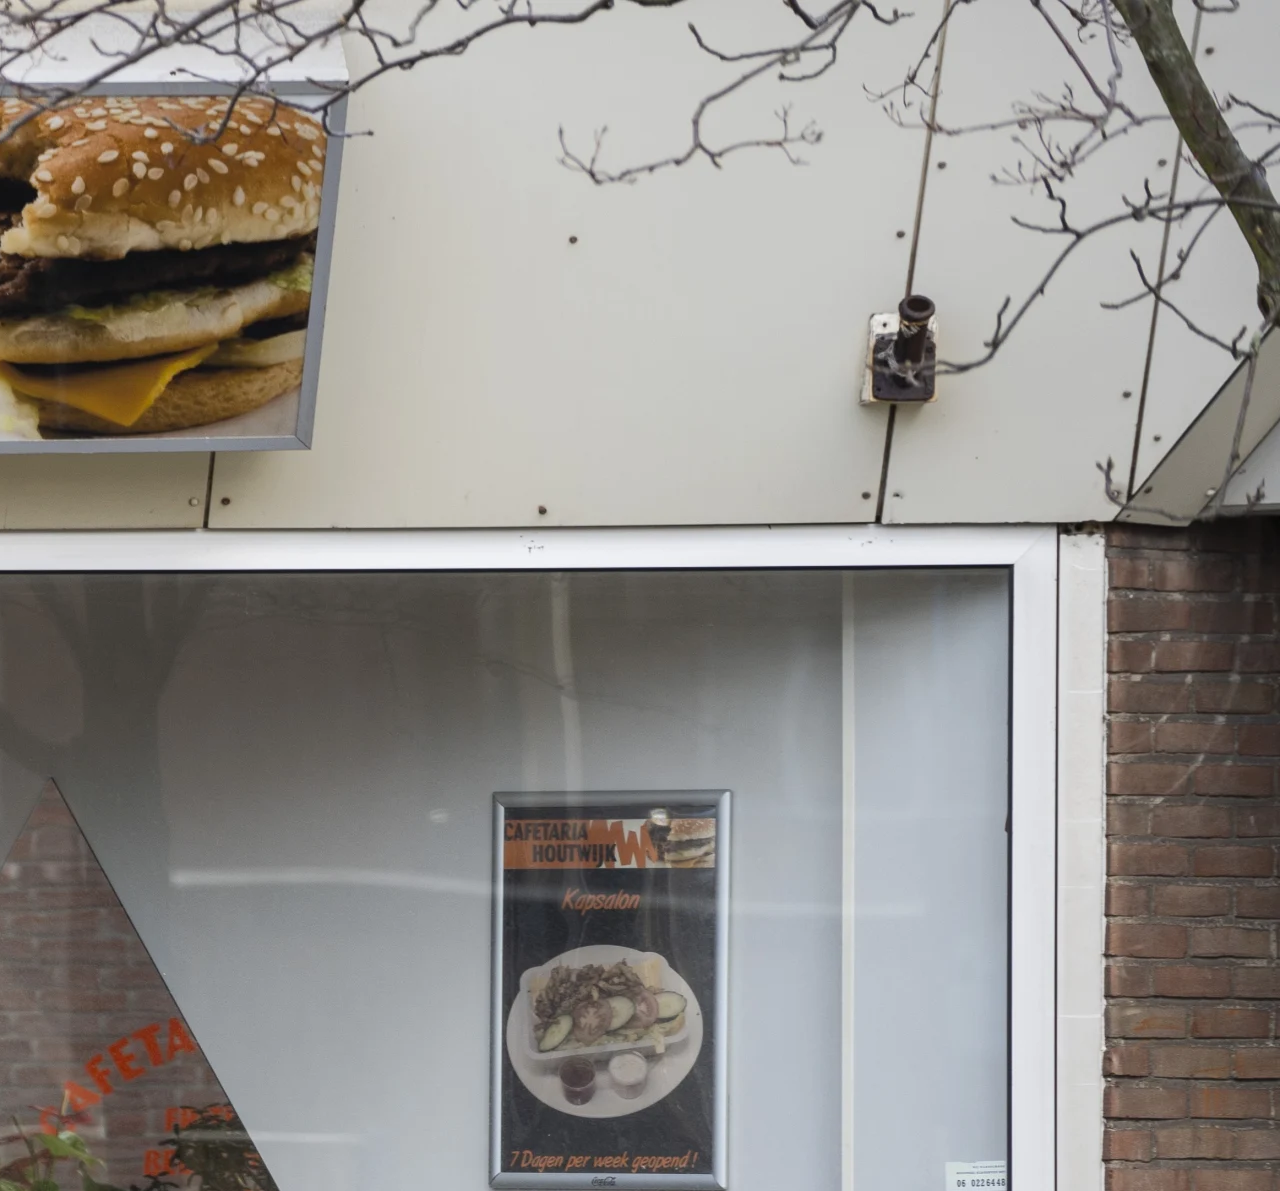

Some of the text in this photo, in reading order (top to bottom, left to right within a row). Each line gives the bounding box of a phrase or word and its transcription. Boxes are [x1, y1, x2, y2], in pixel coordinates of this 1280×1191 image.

[504, 821, 588, 842] CAFETARIA
[532, 843, 617, 868] HOUTWIJK
[561, 887, 640, 916] Kapsalon
[510, 1151, 519, 1166] 7
[520, 1151, 564, 1171] Dagen
[564, 1155, 590, 1172] per
[593, 1153, 629, 1169] week
[632, 1151, 689, 1173] geopend
[956, 1179, 967, 1188] 06
